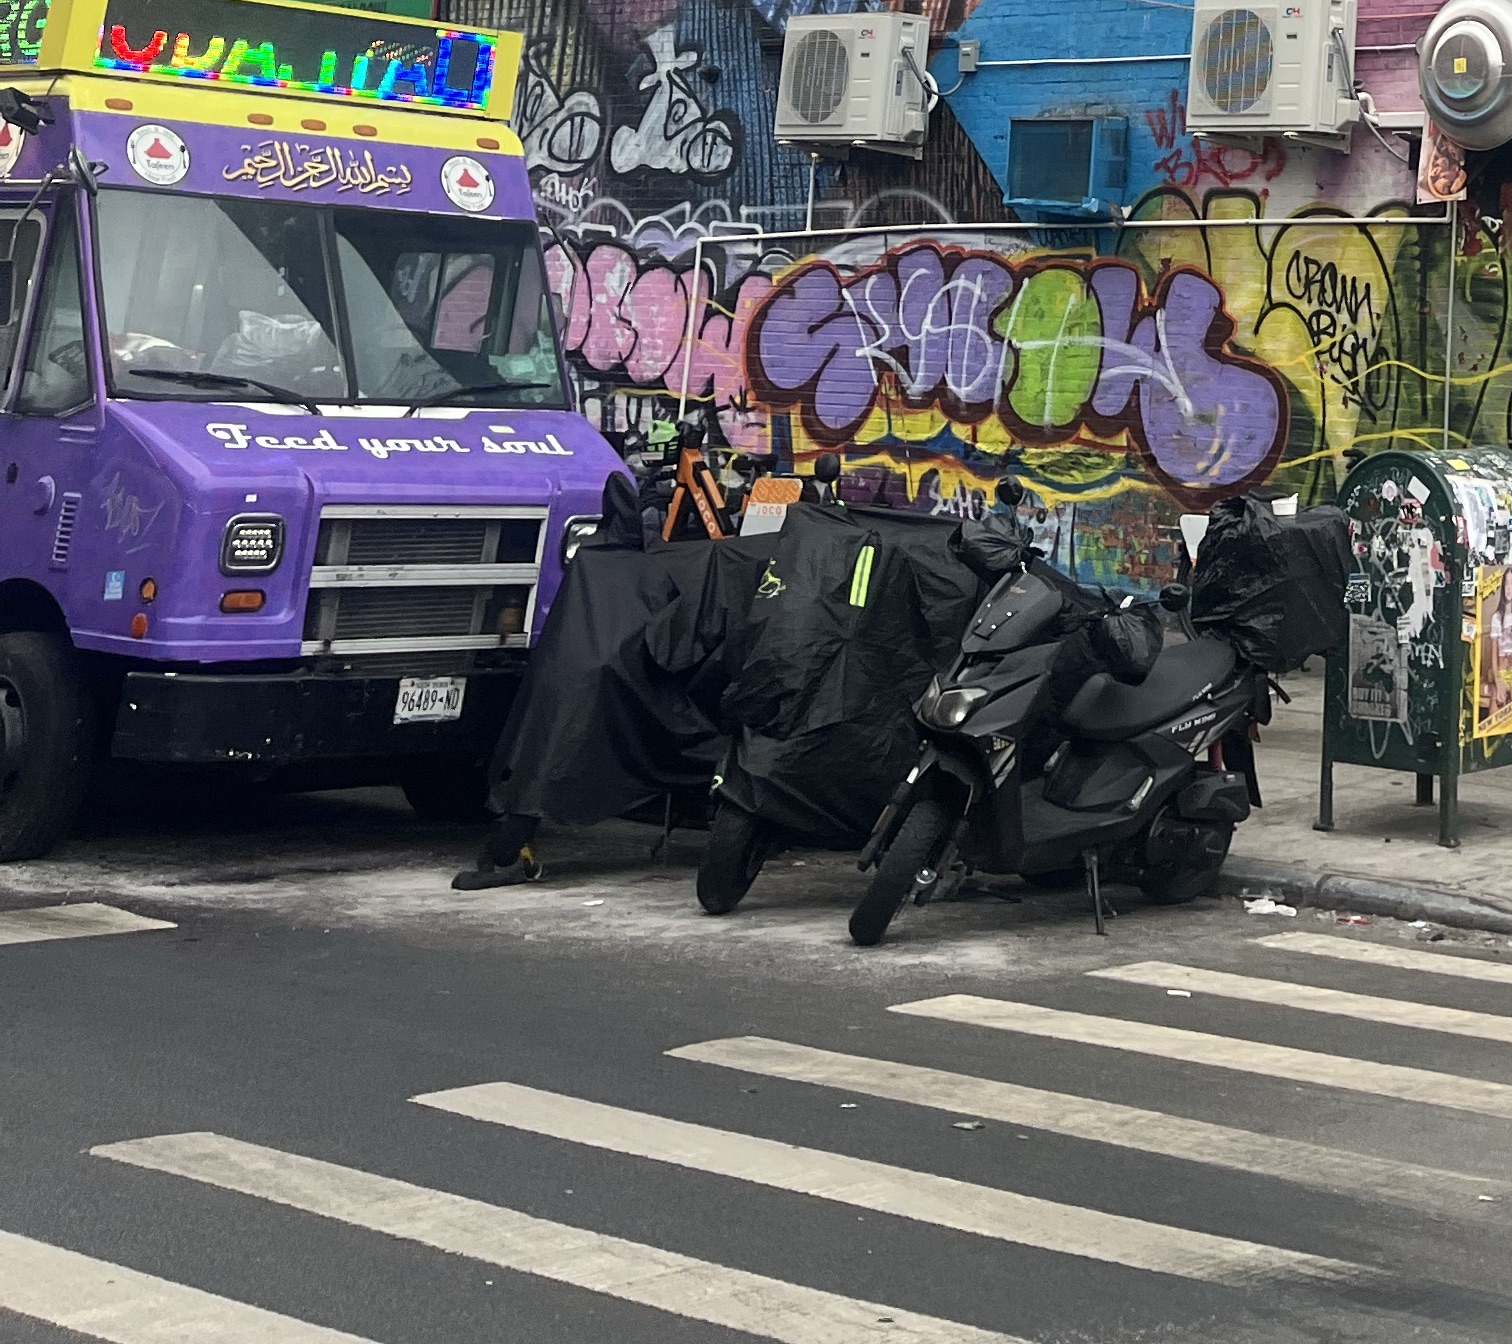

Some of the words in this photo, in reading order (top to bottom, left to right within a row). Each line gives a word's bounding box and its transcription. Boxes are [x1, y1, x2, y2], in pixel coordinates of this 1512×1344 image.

[206, 422, 348, 450] Feed
[358, 436, 470, 459] your
[482, 435, 574, 455] soul
